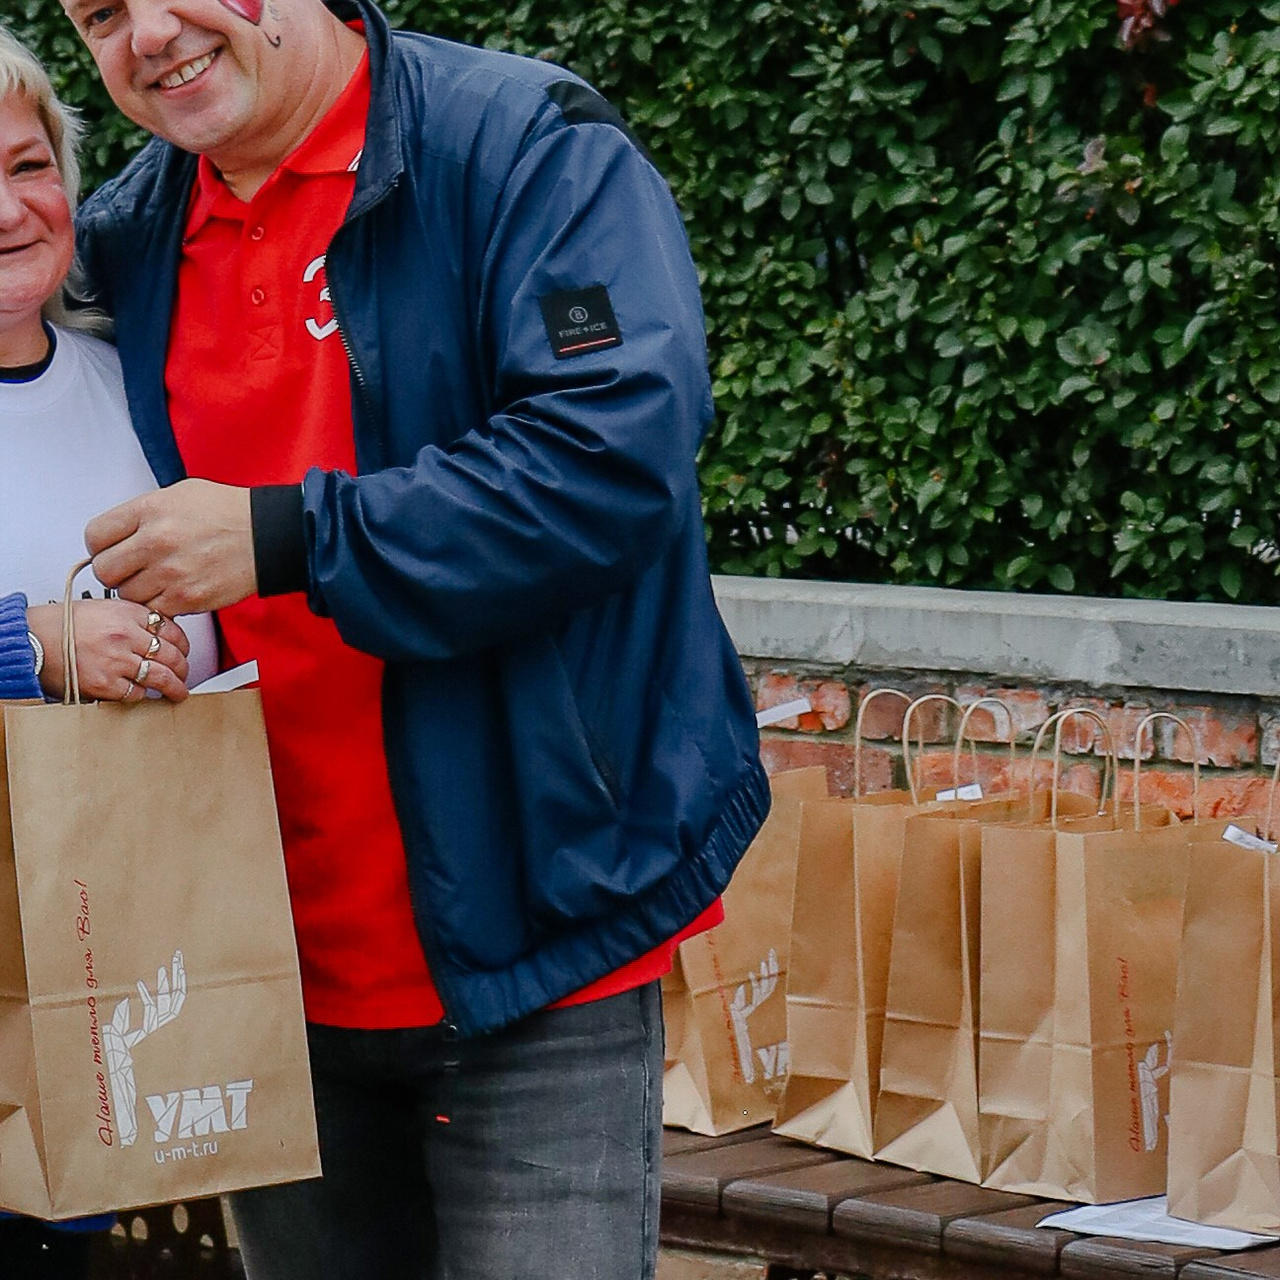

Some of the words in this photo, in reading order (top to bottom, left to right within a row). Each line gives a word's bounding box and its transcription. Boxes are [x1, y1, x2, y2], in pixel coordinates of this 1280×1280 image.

[85, 948, 98, 990] для
[85, 996, 104, 1065] тепло
[96, 1071, 114, 1147] Наше
[145, 1078, 254, 1144] УМТ
[154, 1141, 219, 1165] u-m-t.ru
